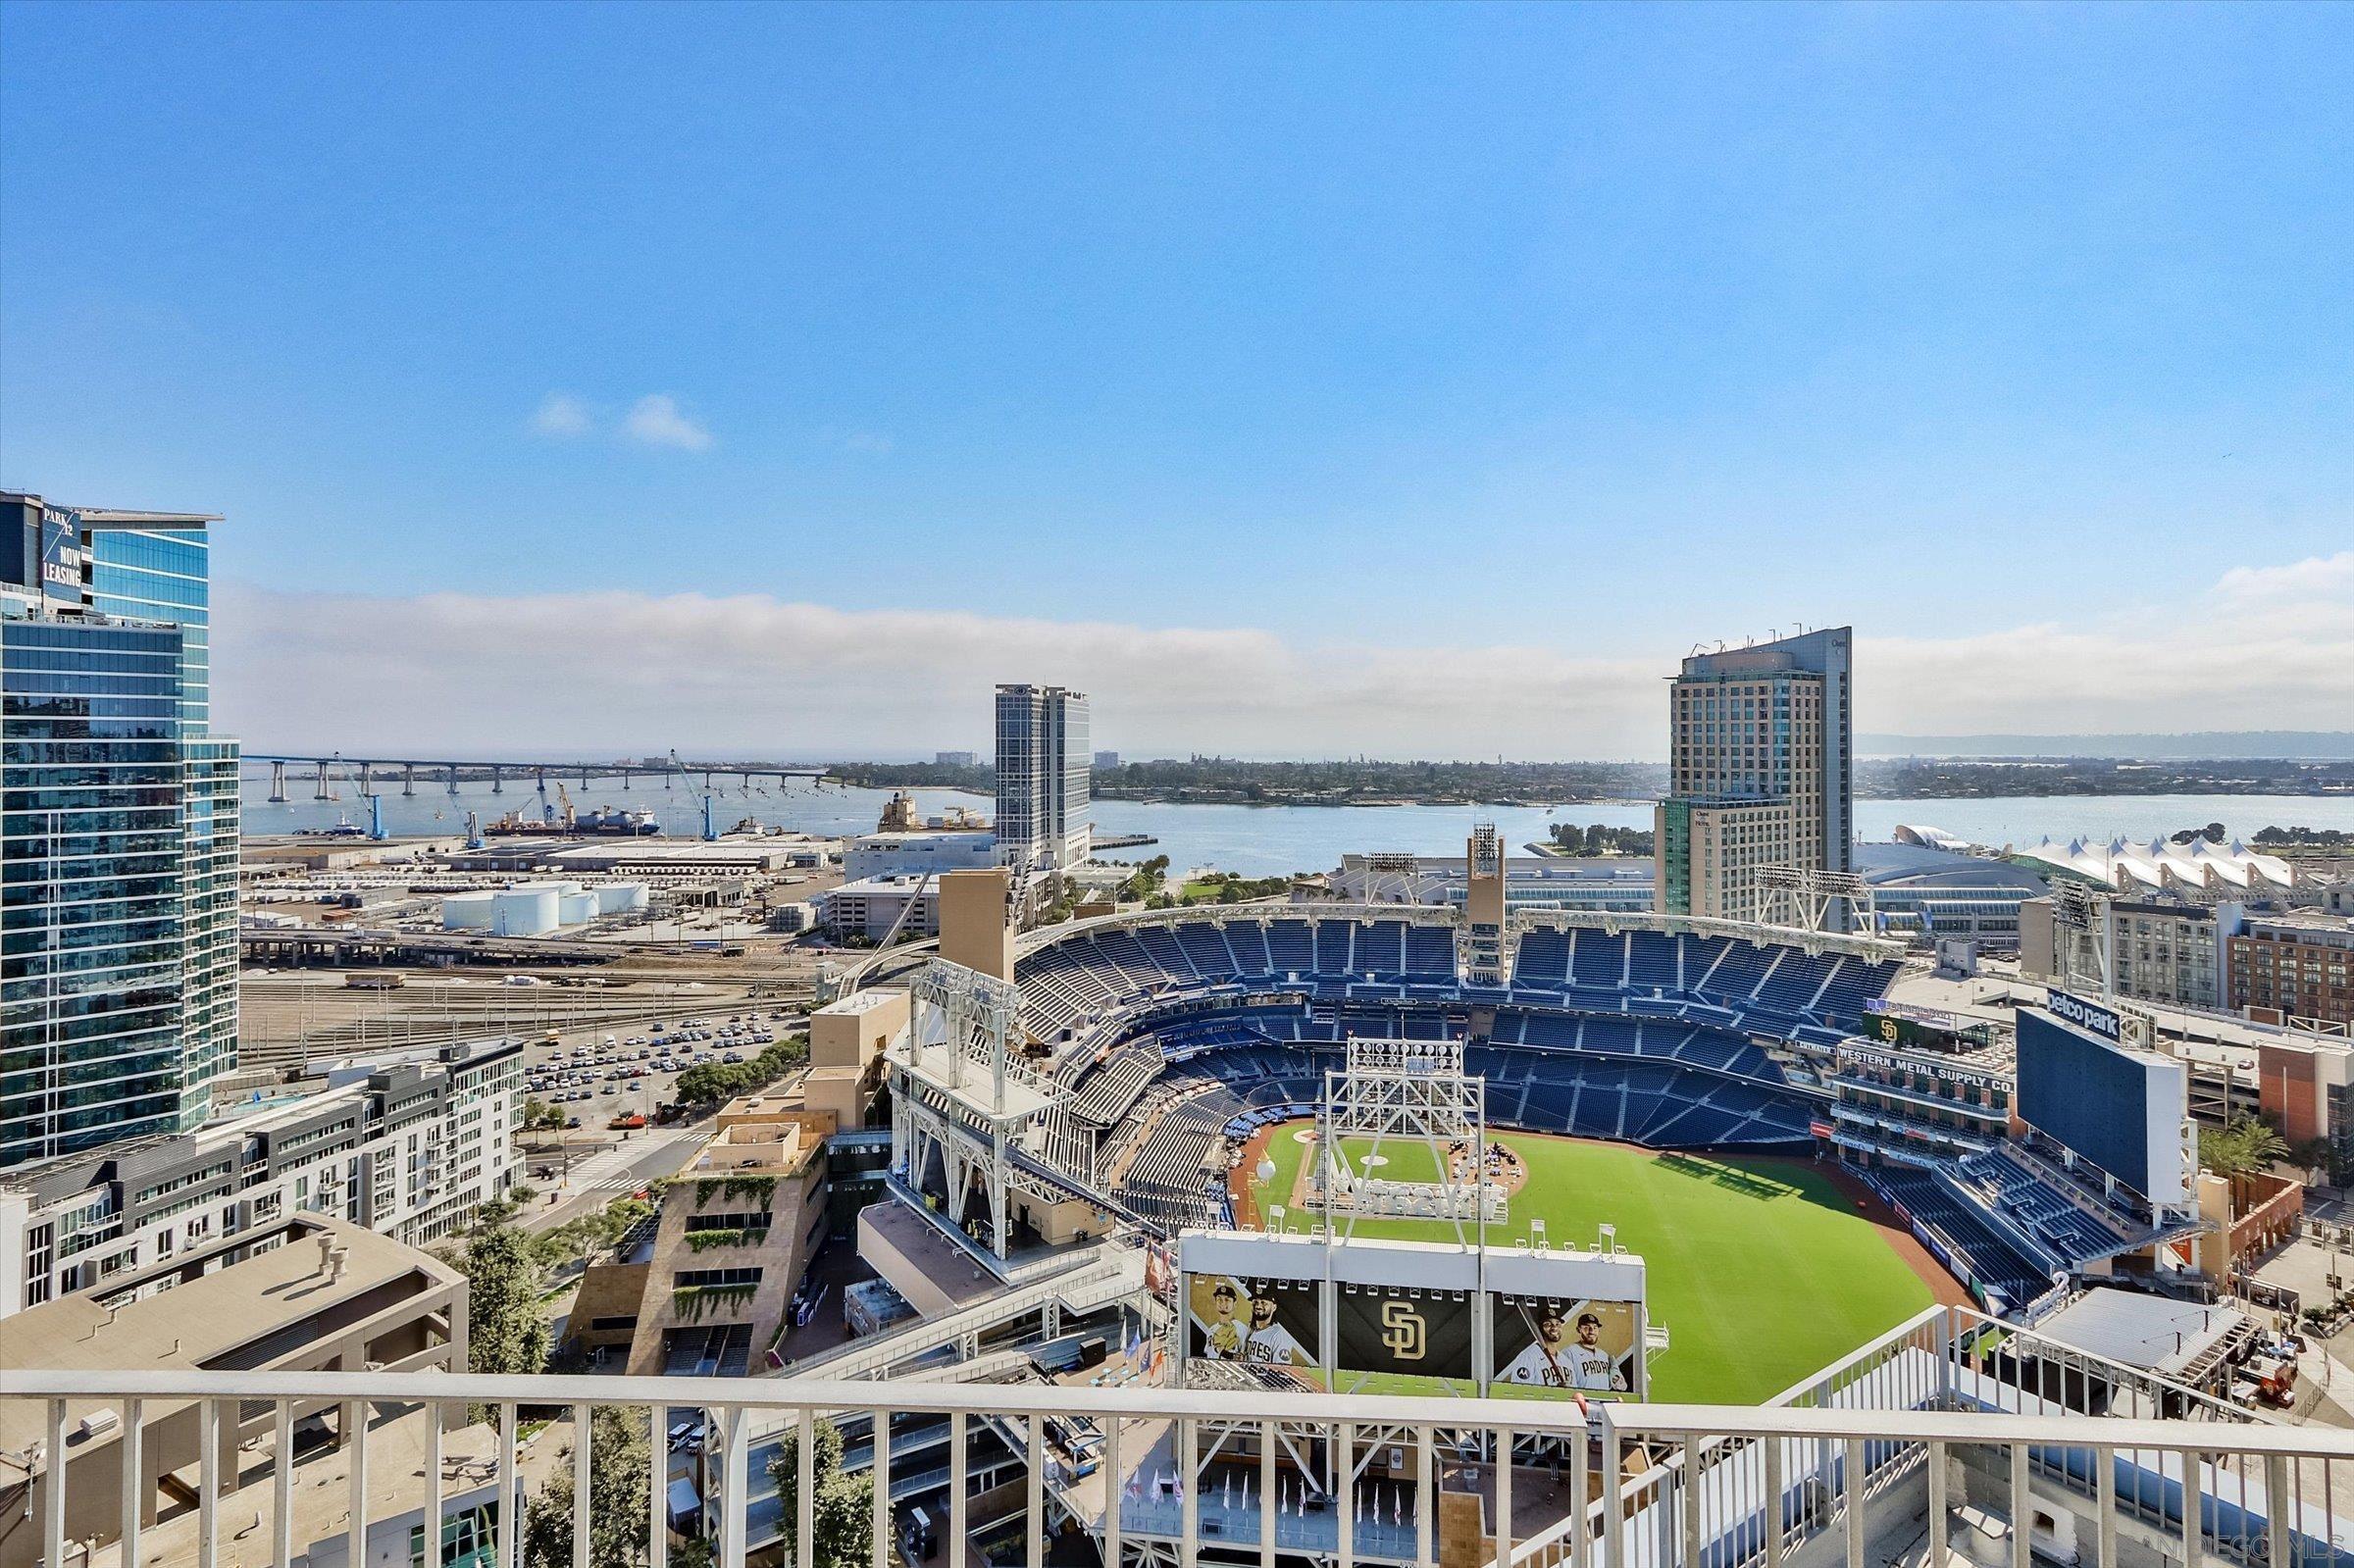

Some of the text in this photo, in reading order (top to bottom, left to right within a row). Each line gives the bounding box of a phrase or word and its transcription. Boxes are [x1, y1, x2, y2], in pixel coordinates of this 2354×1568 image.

[44, 508, 67, 527] PARK
[60, 545, 80, 567] NOW
[44, 562, 81, 587] LEASING
[2047, 993, 2118, 1036] petco park
[1881, 1019, 1898, 1041] SD
[1838, 1047, 2016, 1094] WESTERN METAL SUPPLY CO.
[1381, 1300, 1426, 1360] SD
